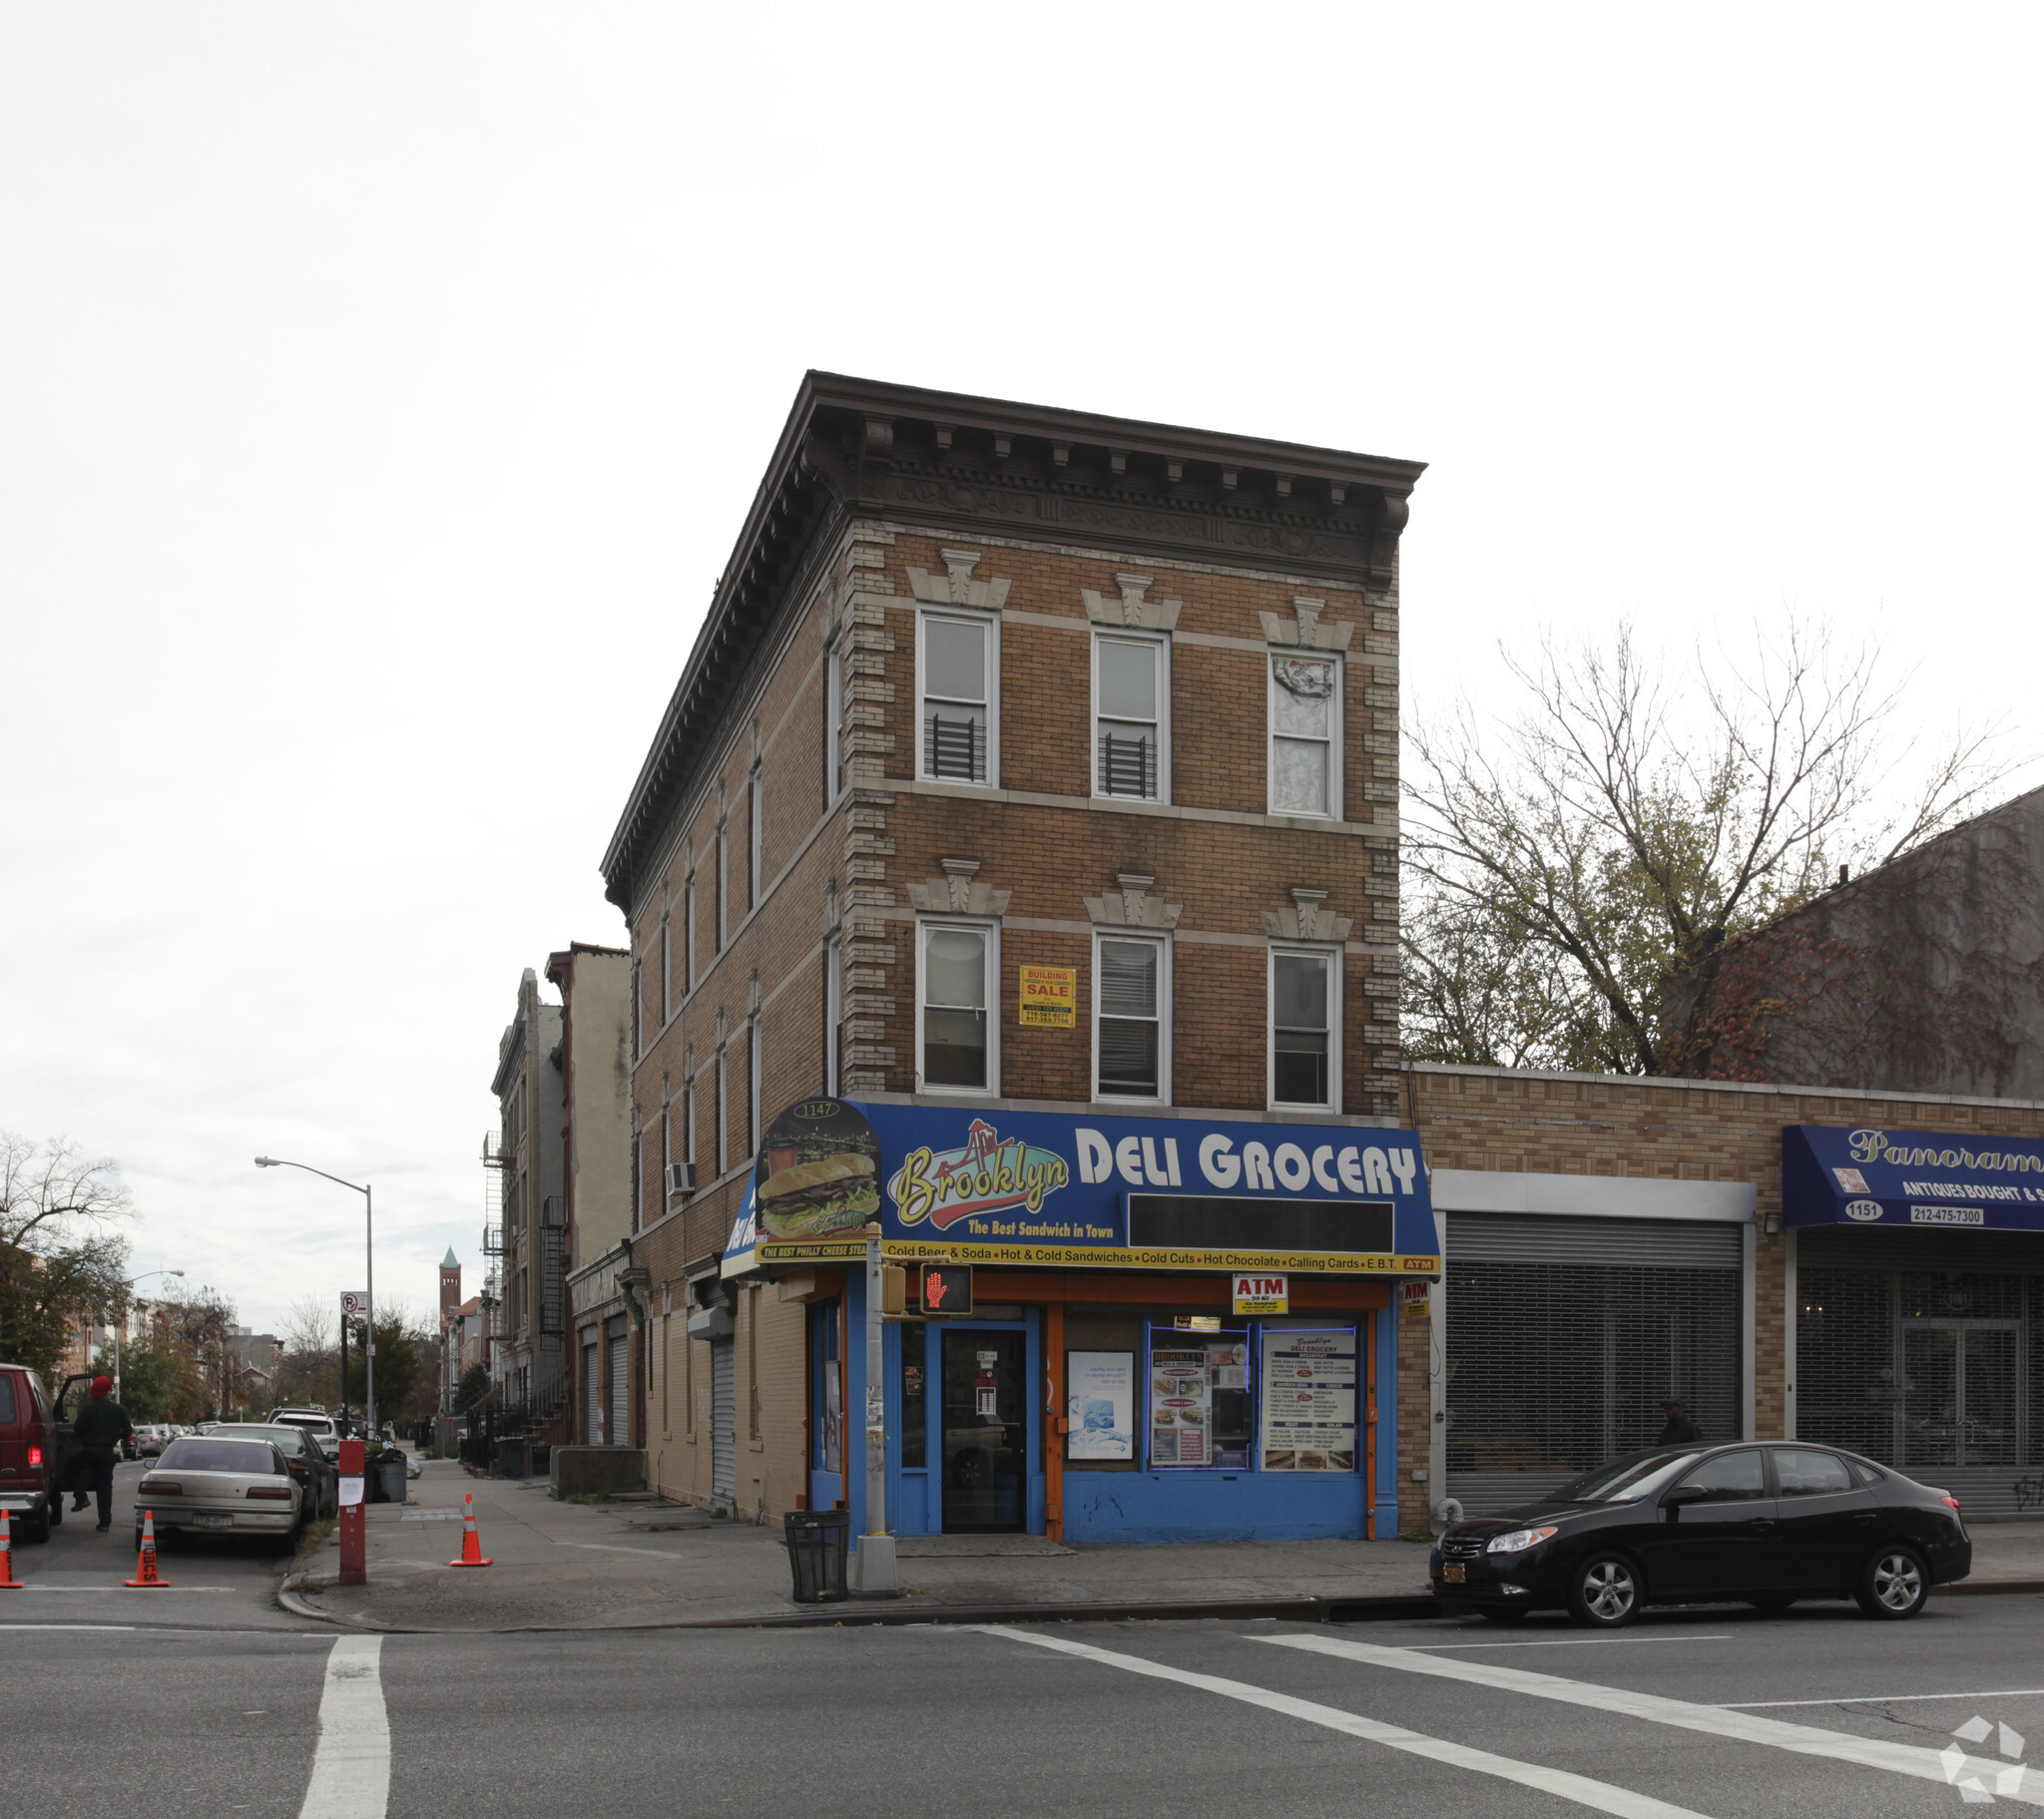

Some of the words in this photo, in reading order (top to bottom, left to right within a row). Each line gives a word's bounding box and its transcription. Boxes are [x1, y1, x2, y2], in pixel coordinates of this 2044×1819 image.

[1028, 971, 1068, 980] BUILDING
[1027, 984, 1069, 997] SALE
[802, 1104, 831, 1117] 1147
[1075, 1128, 1182, 1186] DELI
[1199, 1134, 1416, 1195] GROCERY
[895, 1142, 1069, 1224] Brooklyn
[1902, 1181, 1965, 1198] ANTIQUES
[1962, 1184, 2022, 1201] BOUGHT
[2023, 1187, 2037, 1202] &
[1848, 1203, 1877, 1216] 1151
[1914, 1208, 1980, 1222] 212-475-7300
[968, 1219, 988, 1235] The
[991, 1220, 1016, 1236] Best
[1019, 1221, 1070, 1238] Sandwich
[1073, 1223, 1083, 1237] in
[1086, 1224, 1114, 1238] Town
[765, 1247, 776, 1257] THE
[778, 1246, 794, 1256] BEST
[796, 1245, 821, 1256] PHILLY
[822, 1245, 847, 1255] CHEESE
[848, 1245, 866, 1255] STEA
[888, 1245, 915, 1256] Cold
[919, 1246, 947, 1257] Beer
[950, 1247, 958, 1258] &
[962, 1247, 991, 1259] Soda
[1001, 1249, 1020, 1260] Hot
[1024, 1249, 1033, 1260] &
[1036, 1249, 1061, 1261] Cold
[1065, 1250, 1133, 1262] Sandwiches
[1142, 1252, 1167, 1263] Cold
[1170, 1253, 1195, 1264] Cuts
[1204, 1254, 1223, 1264] Hot
[1226, 1254, 1279, 1266] Chocolate
[1288, 1257, 1325, 1270] Calling
[1328, 1258, 1359, 1268] Cards
[1367, 1259, 1396, 1269] E.B.T.
[1405, 1260, 1432, 1269] ATM
[1237, 1279, 1283, 1295] ATM
[1405, 1282, 1428, 1300] ATM
[1296, 1337, 1331, 1346] Brooklyn
[1155, 1352, 1204, 1361] BROOKLYN
